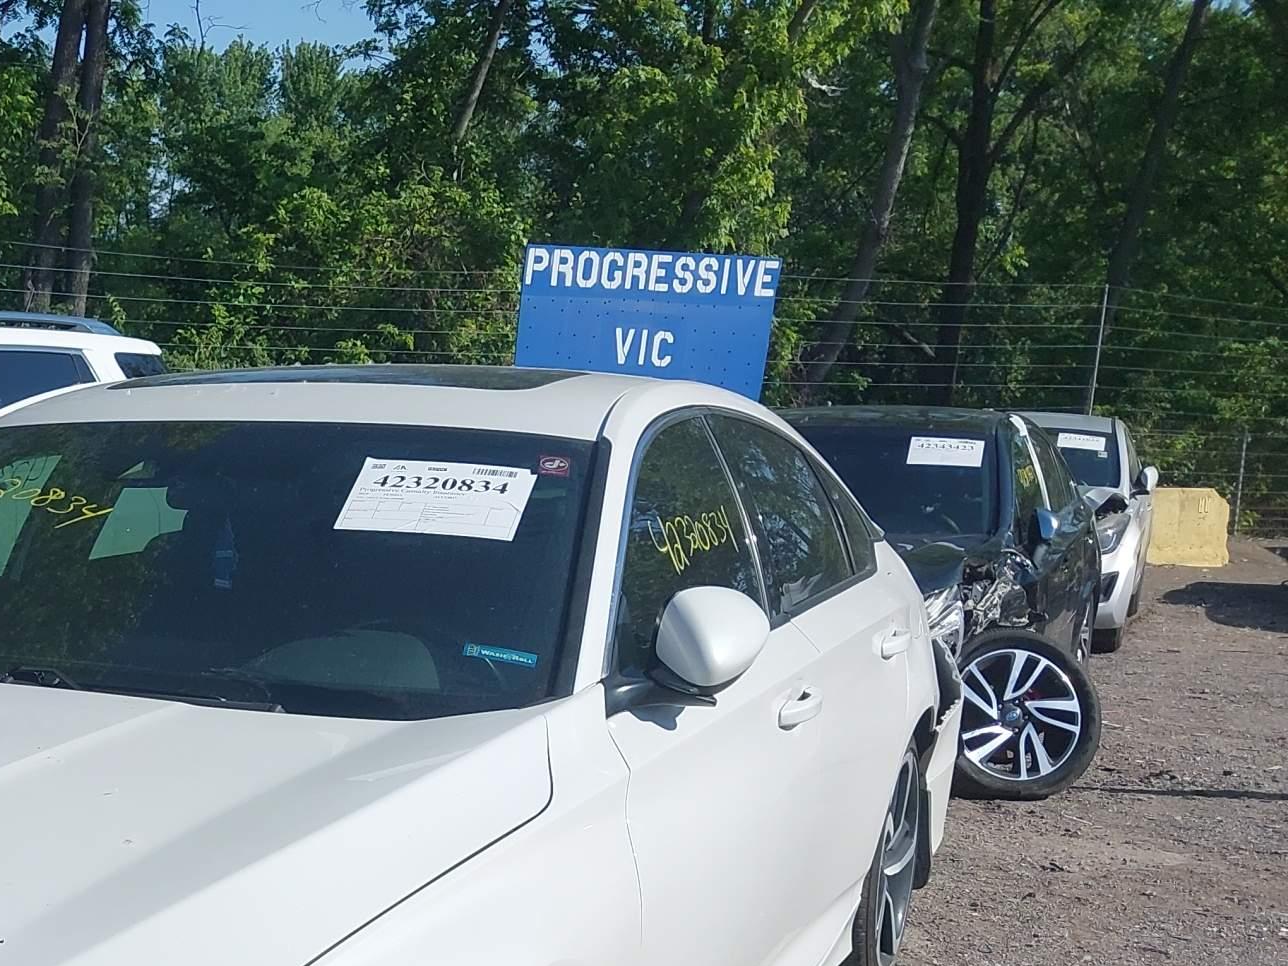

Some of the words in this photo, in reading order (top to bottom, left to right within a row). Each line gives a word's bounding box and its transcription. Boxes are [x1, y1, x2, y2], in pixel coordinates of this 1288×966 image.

[525, 247, 780, 297] PROGRESSIVE
[615, 327, 675, 368] VIC
[372, 474, 510, 495] 42320834
[647, 504, 740, 577] 42320834
